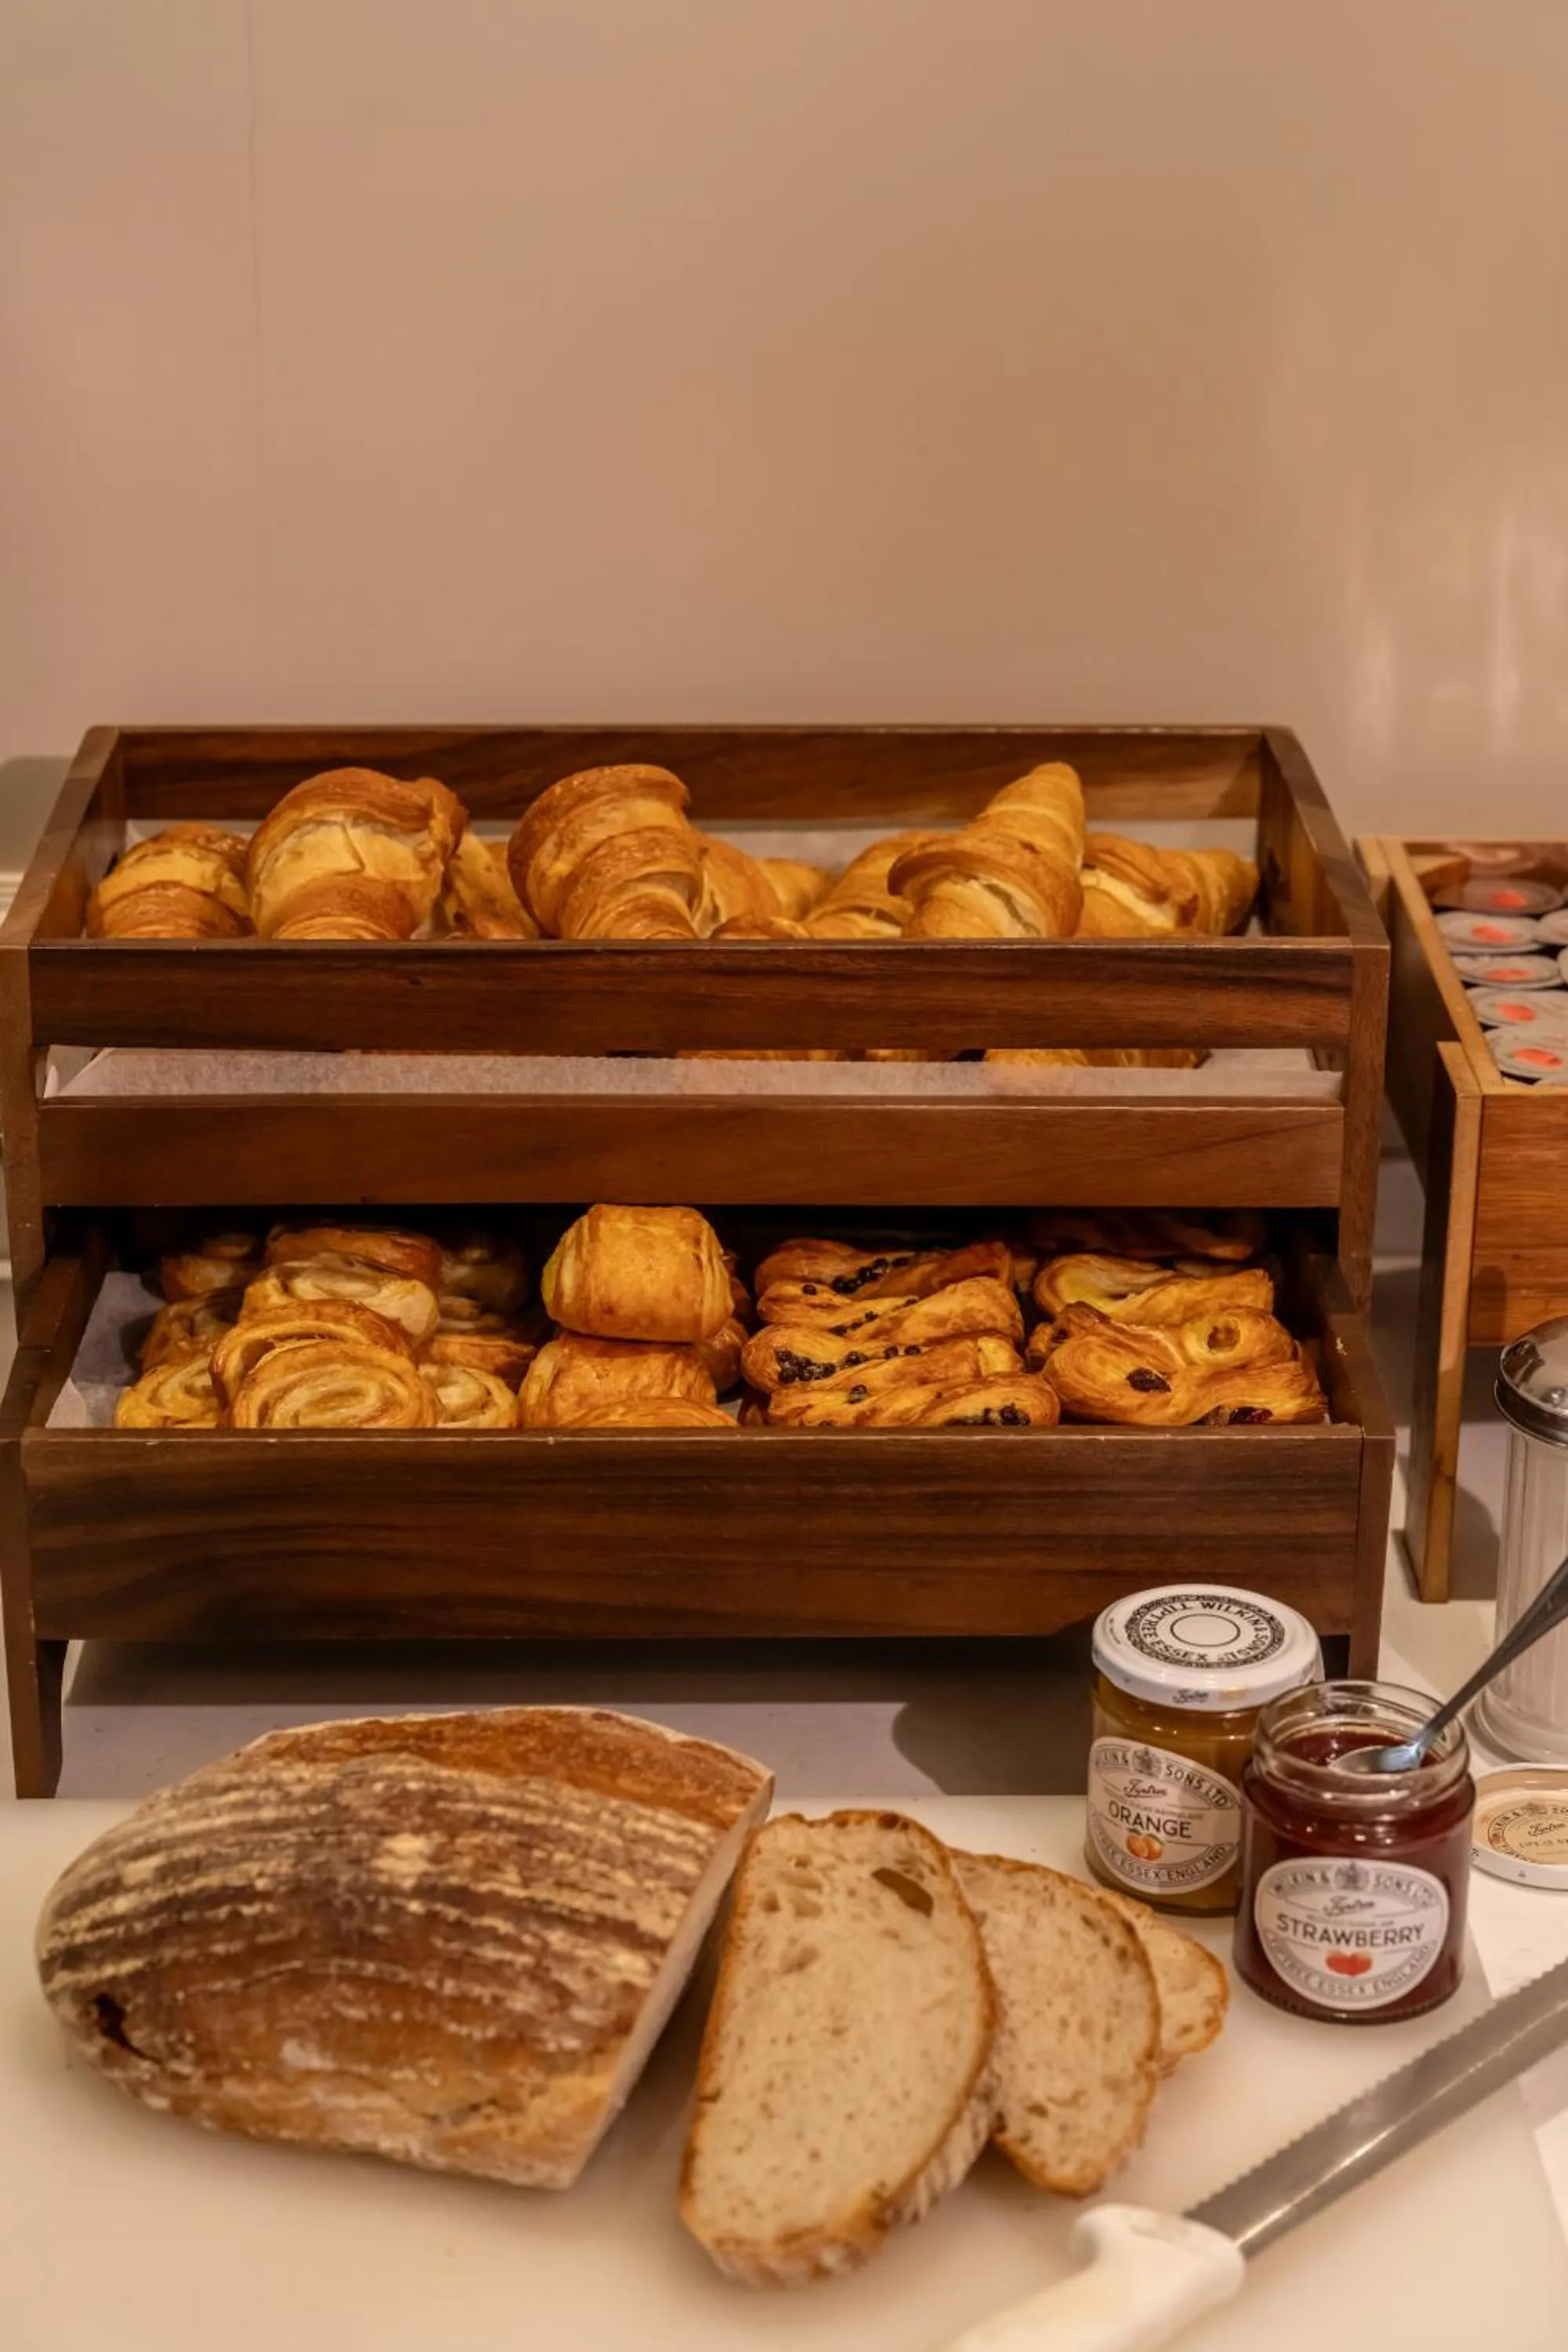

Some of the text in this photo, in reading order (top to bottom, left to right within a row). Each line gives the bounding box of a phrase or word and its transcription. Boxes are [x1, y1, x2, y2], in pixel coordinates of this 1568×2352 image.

[1166, 1764, 1204, 1791] SONS
[1205, 1784, 1228, 1808] LTD
[1108, 1800, 1192, 1839] ORANGE
[1167, 1845, 1227, 1881] ENGLAND
[1276, 1912, 1425, 1948] STRAWBERRY
